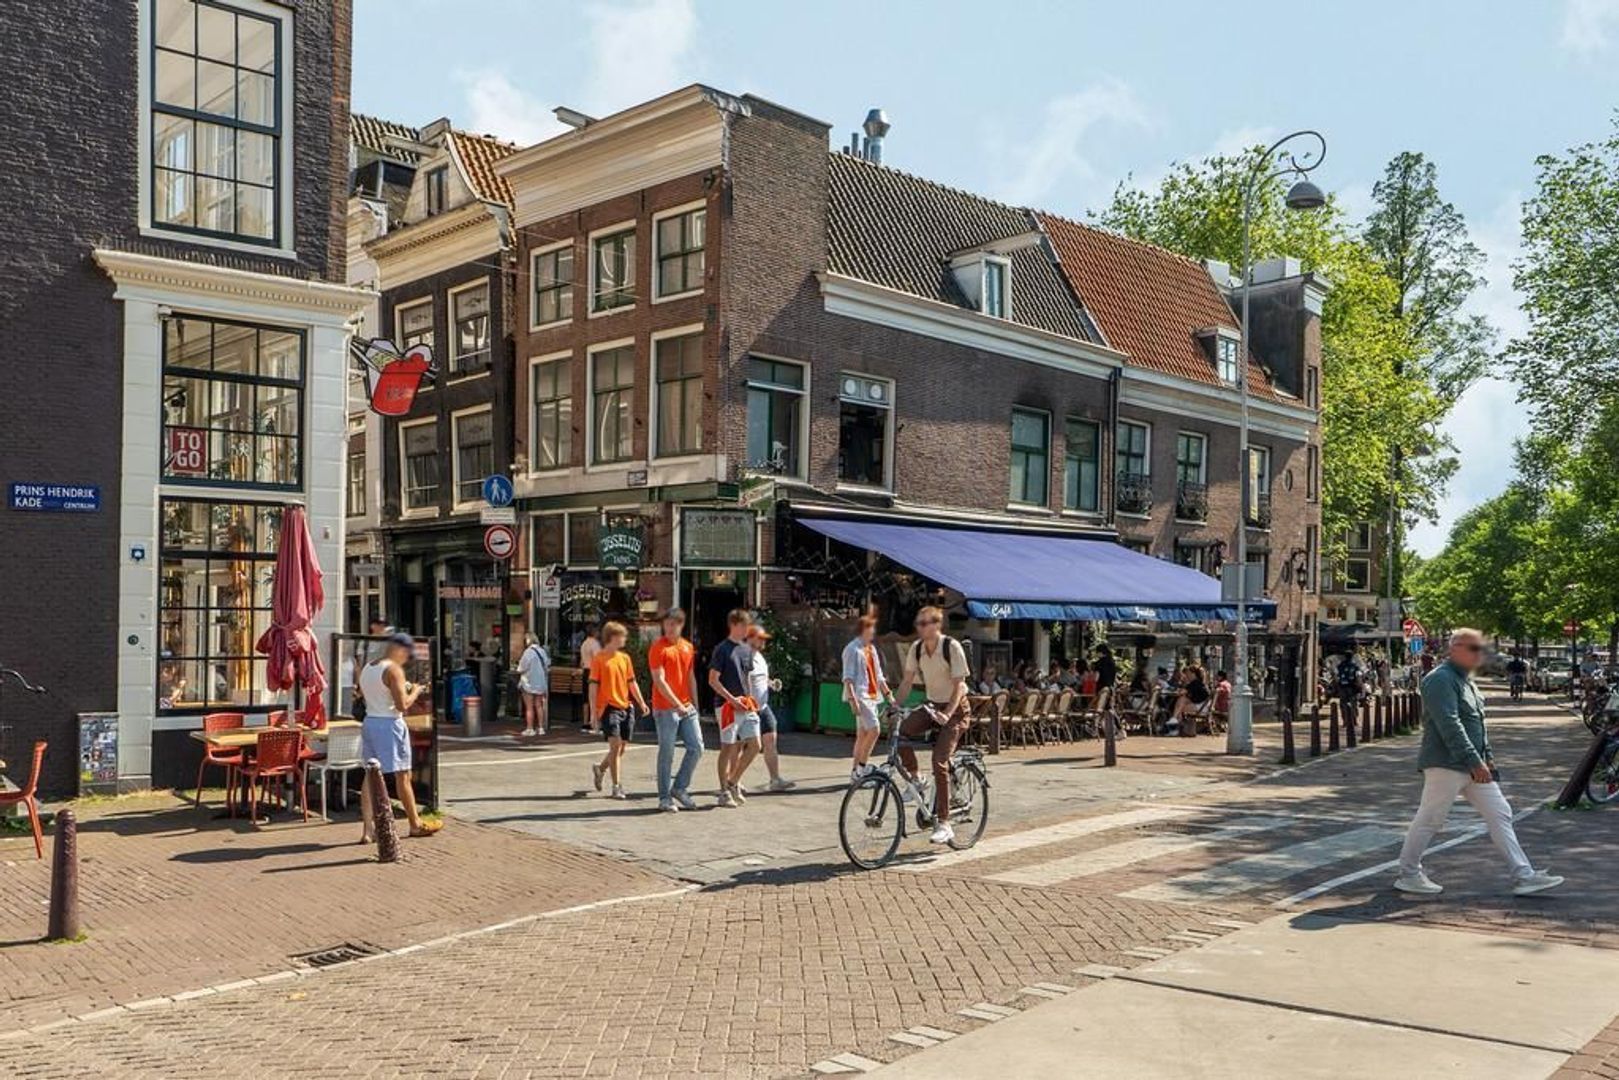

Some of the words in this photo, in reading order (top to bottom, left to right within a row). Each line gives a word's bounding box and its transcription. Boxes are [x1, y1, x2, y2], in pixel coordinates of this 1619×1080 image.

[177, 432, 201, 450] TO
[176, 449, 201, 468] GO
[14, 485, 46, 496] PRINS
[47, 486, 95, 499] HENDRIK
[15, 497, 43, 508] KADE
[63, 501, 96, 509] CENTRUM
